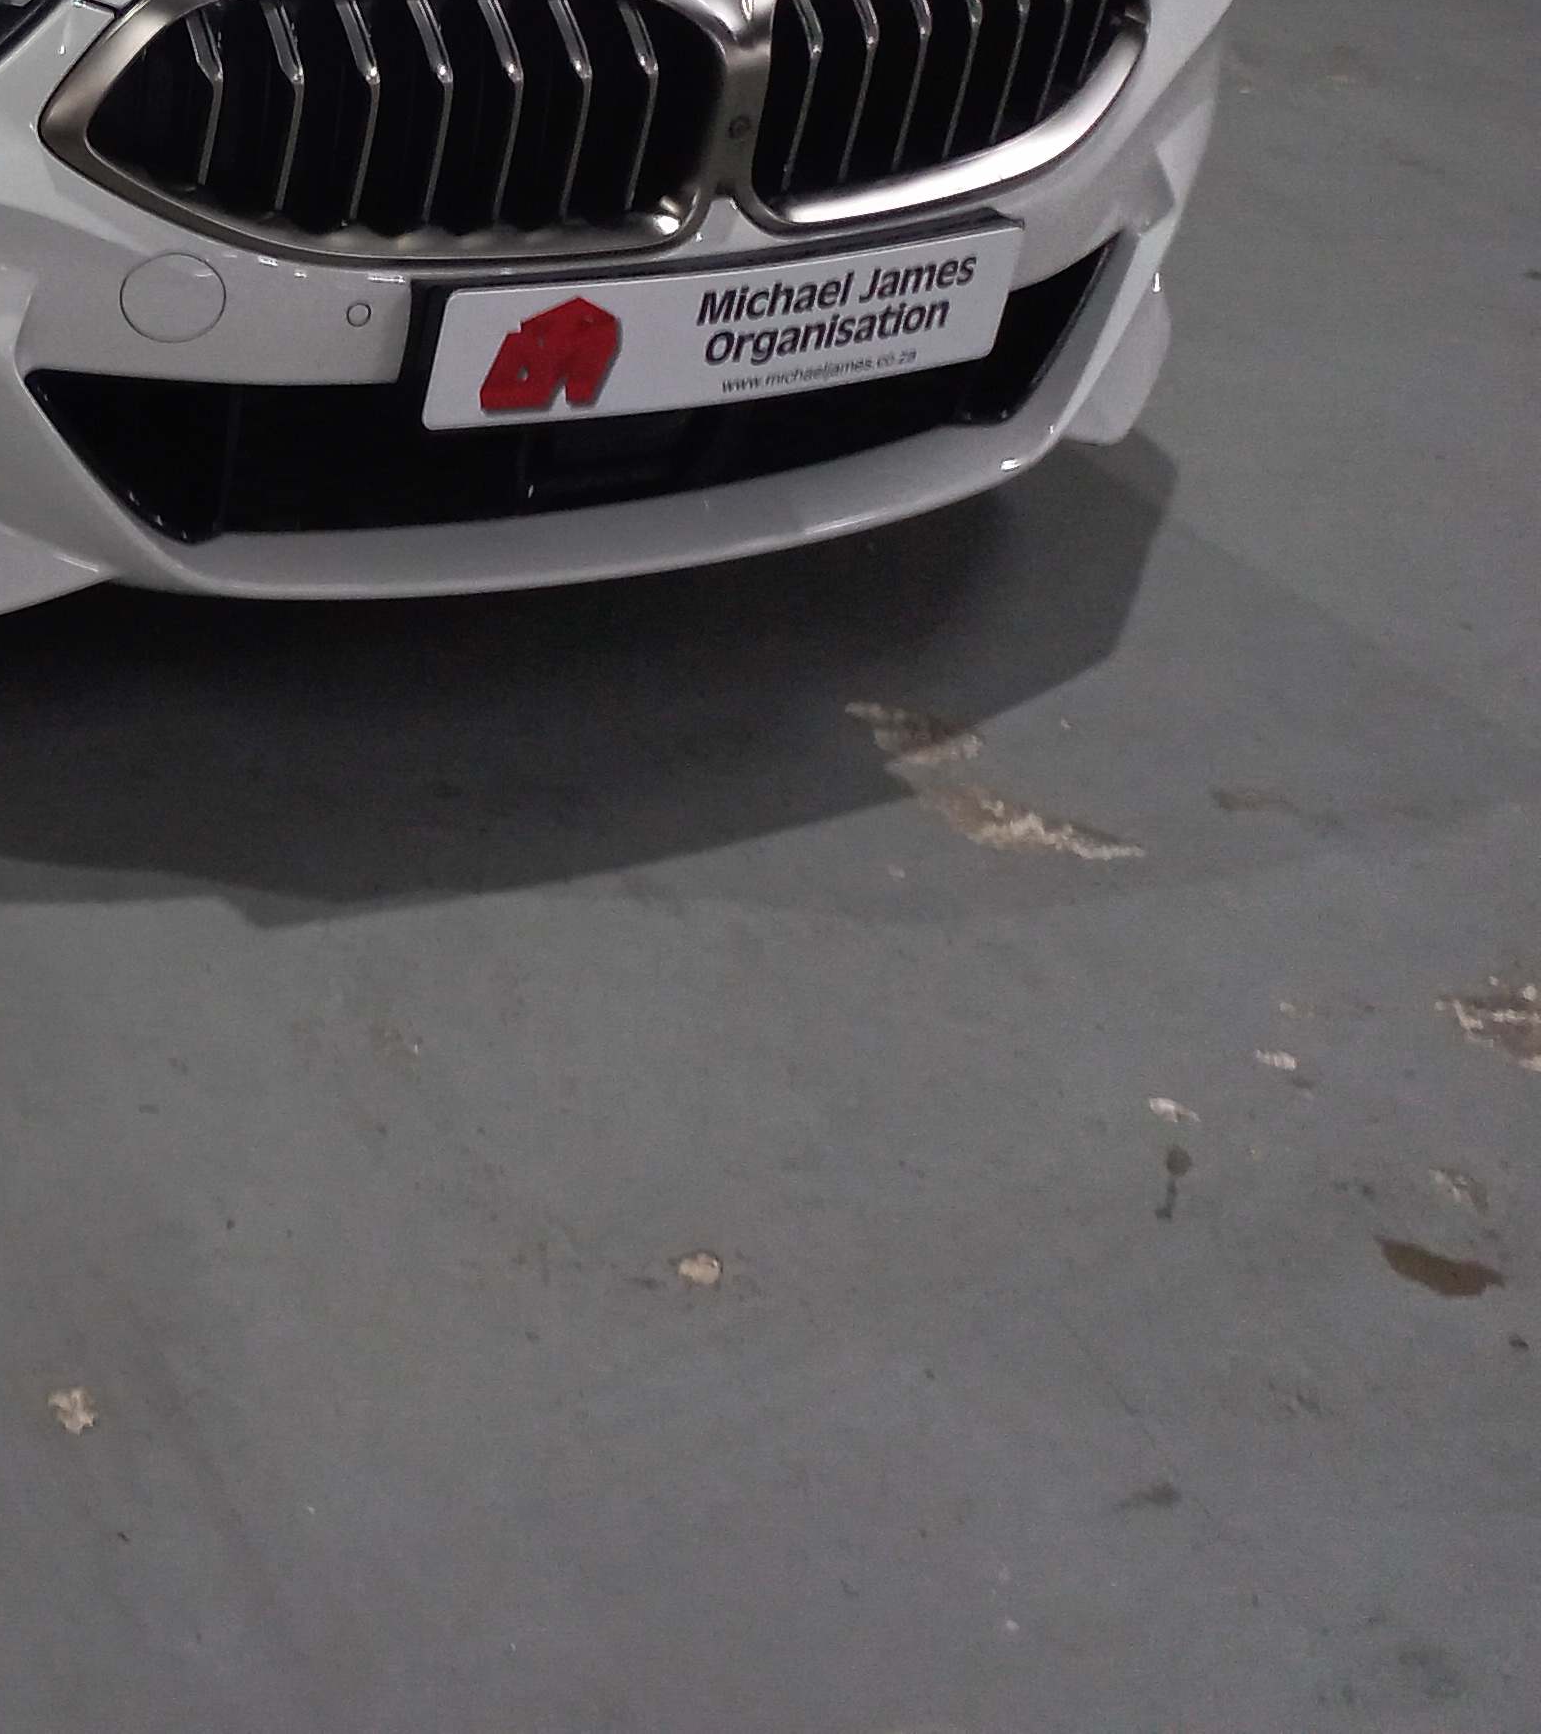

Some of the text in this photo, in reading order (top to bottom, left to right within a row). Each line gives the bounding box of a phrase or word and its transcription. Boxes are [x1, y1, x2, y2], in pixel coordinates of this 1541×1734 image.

[696, 255, 977, 326] Michael James
[705, 299, 950, 366] Organisation
